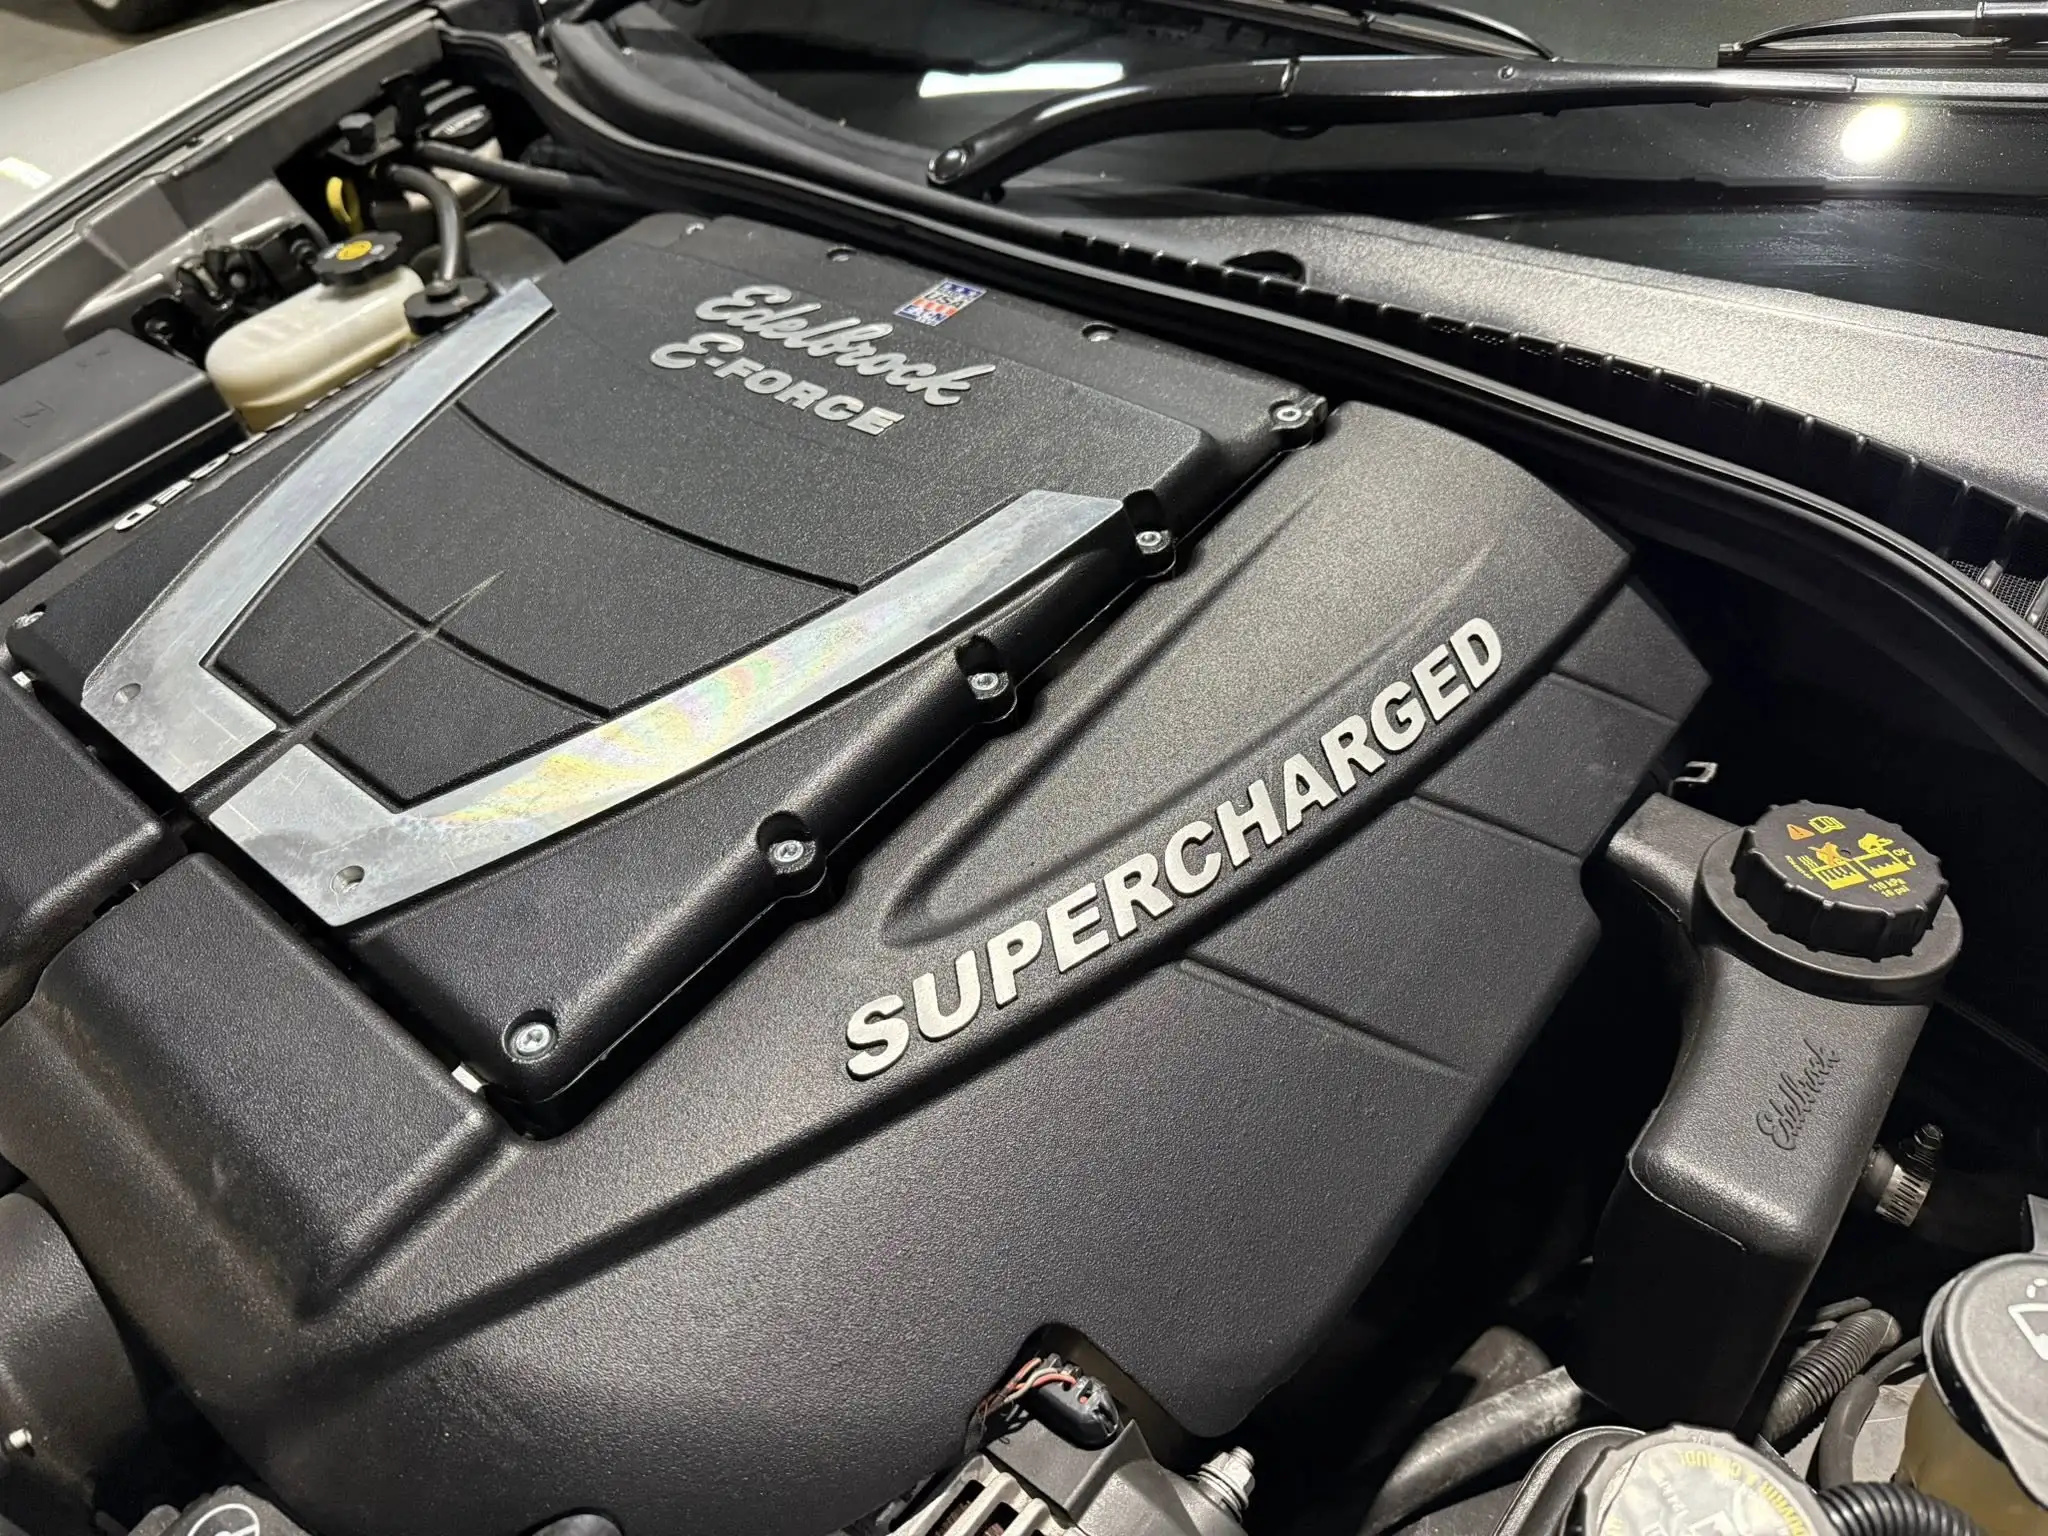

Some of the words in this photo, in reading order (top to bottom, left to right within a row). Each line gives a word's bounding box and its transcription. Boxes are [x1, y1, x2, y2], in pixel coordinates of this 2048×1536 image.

[650, 331, 906, 436] E-FORCE
[695, 284, 997, 406] Edelbrock
[845, 617, 1503, 1081] SUPERCHARGED
[1755, 1038, 1841, 1151] Edelbrock
